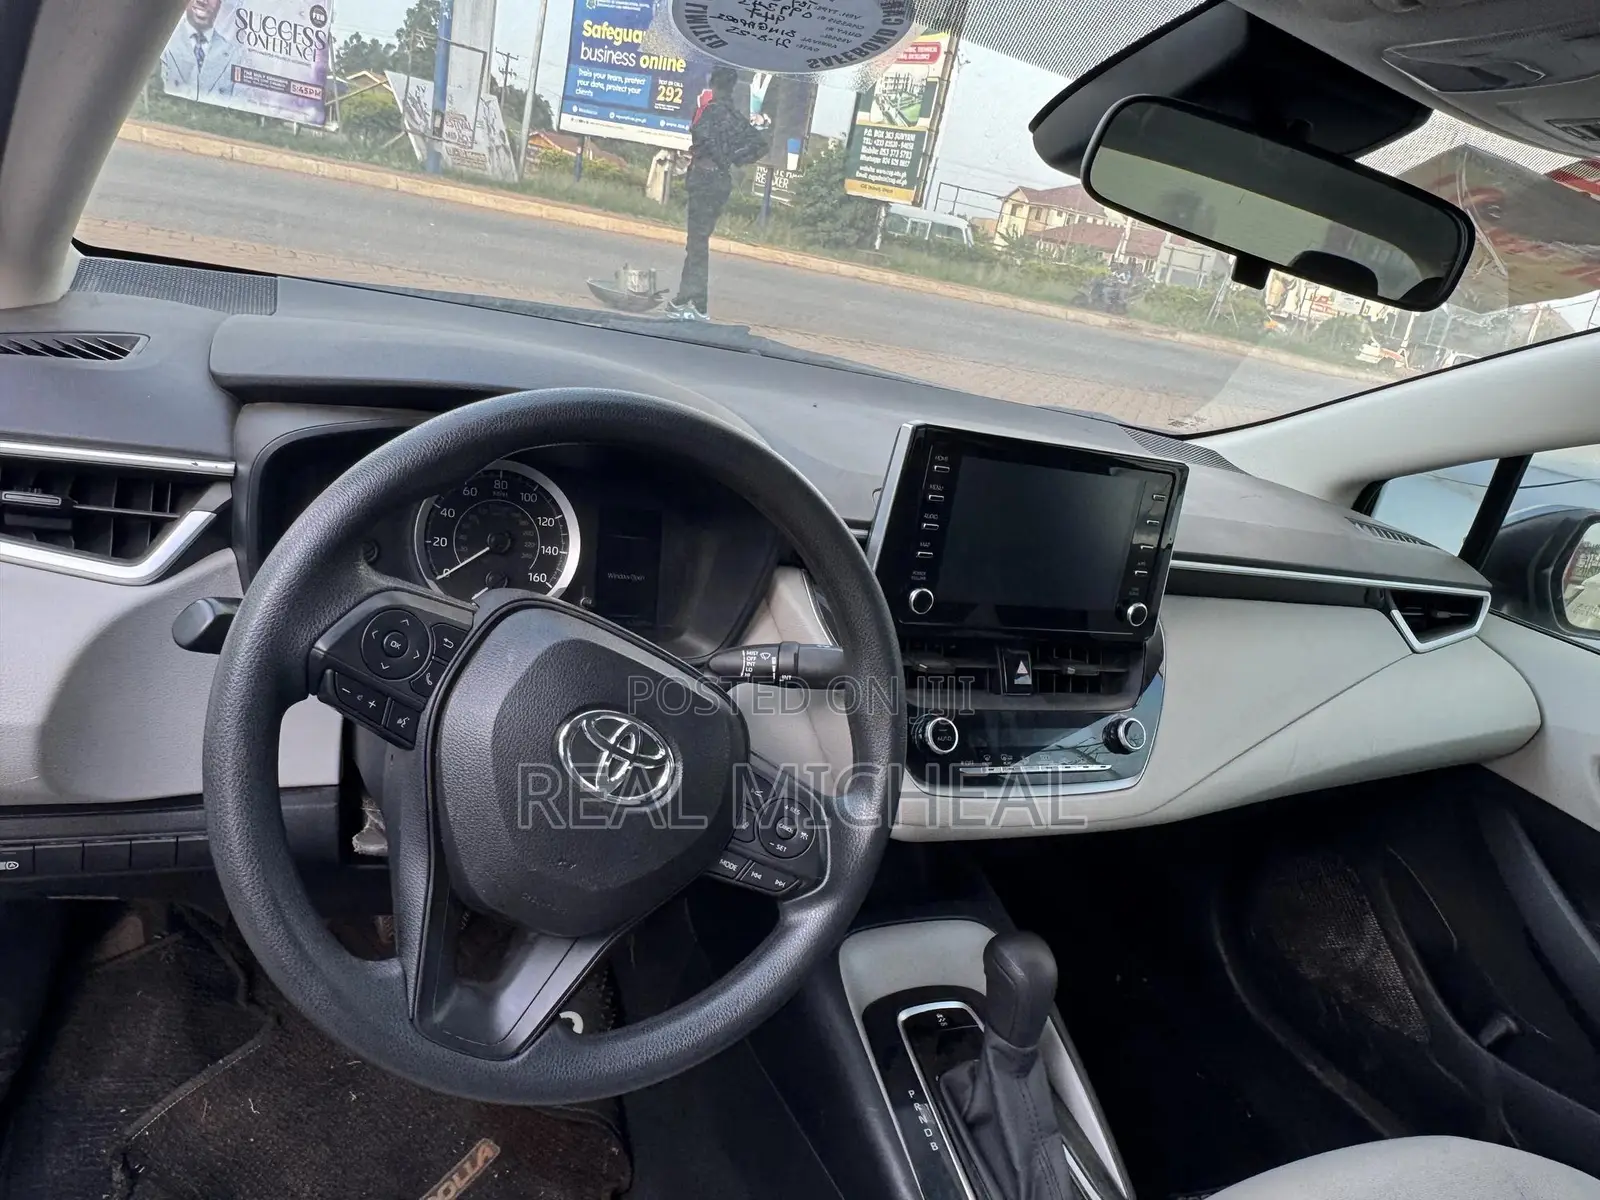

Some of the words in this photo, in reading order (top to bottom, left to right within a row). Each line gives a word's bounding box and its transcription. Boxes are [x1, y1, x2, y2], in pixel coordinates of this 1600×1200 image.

[235, 8, 326, 50] SUCCESS
[581, 42, 637, 67] business
[640, 55, 686, 72] online
[593, 71, 606, 79] your
[577, 79, 590, 87] your
[292, 84, 321, 96] 5:45PM
[657, 86, 683, 103] 292
[756, 173, 789, 189] REXER
[493, 480, 508, 490] 80
[462, 487, 478, 497] 60
[520, 493, 538, 503] 100
[440, 508, 456, 518] 40
[537, 516, 555, 527] 120
[432, 537, 448, 547] 20
[541, 545, 559, 556] 140
[528, 573, 547, 583] 160
[390, 640, 401, 649] OK
[719, 858, 738, 872] MODE
[908, 1089, 915, 1099] P
[913, 1102, 921, 1111] R
[918, 1114, 928, 1124] N
[923, 1128, 933, 1138] D
[426, 1142, 498, 1200] OLLA
